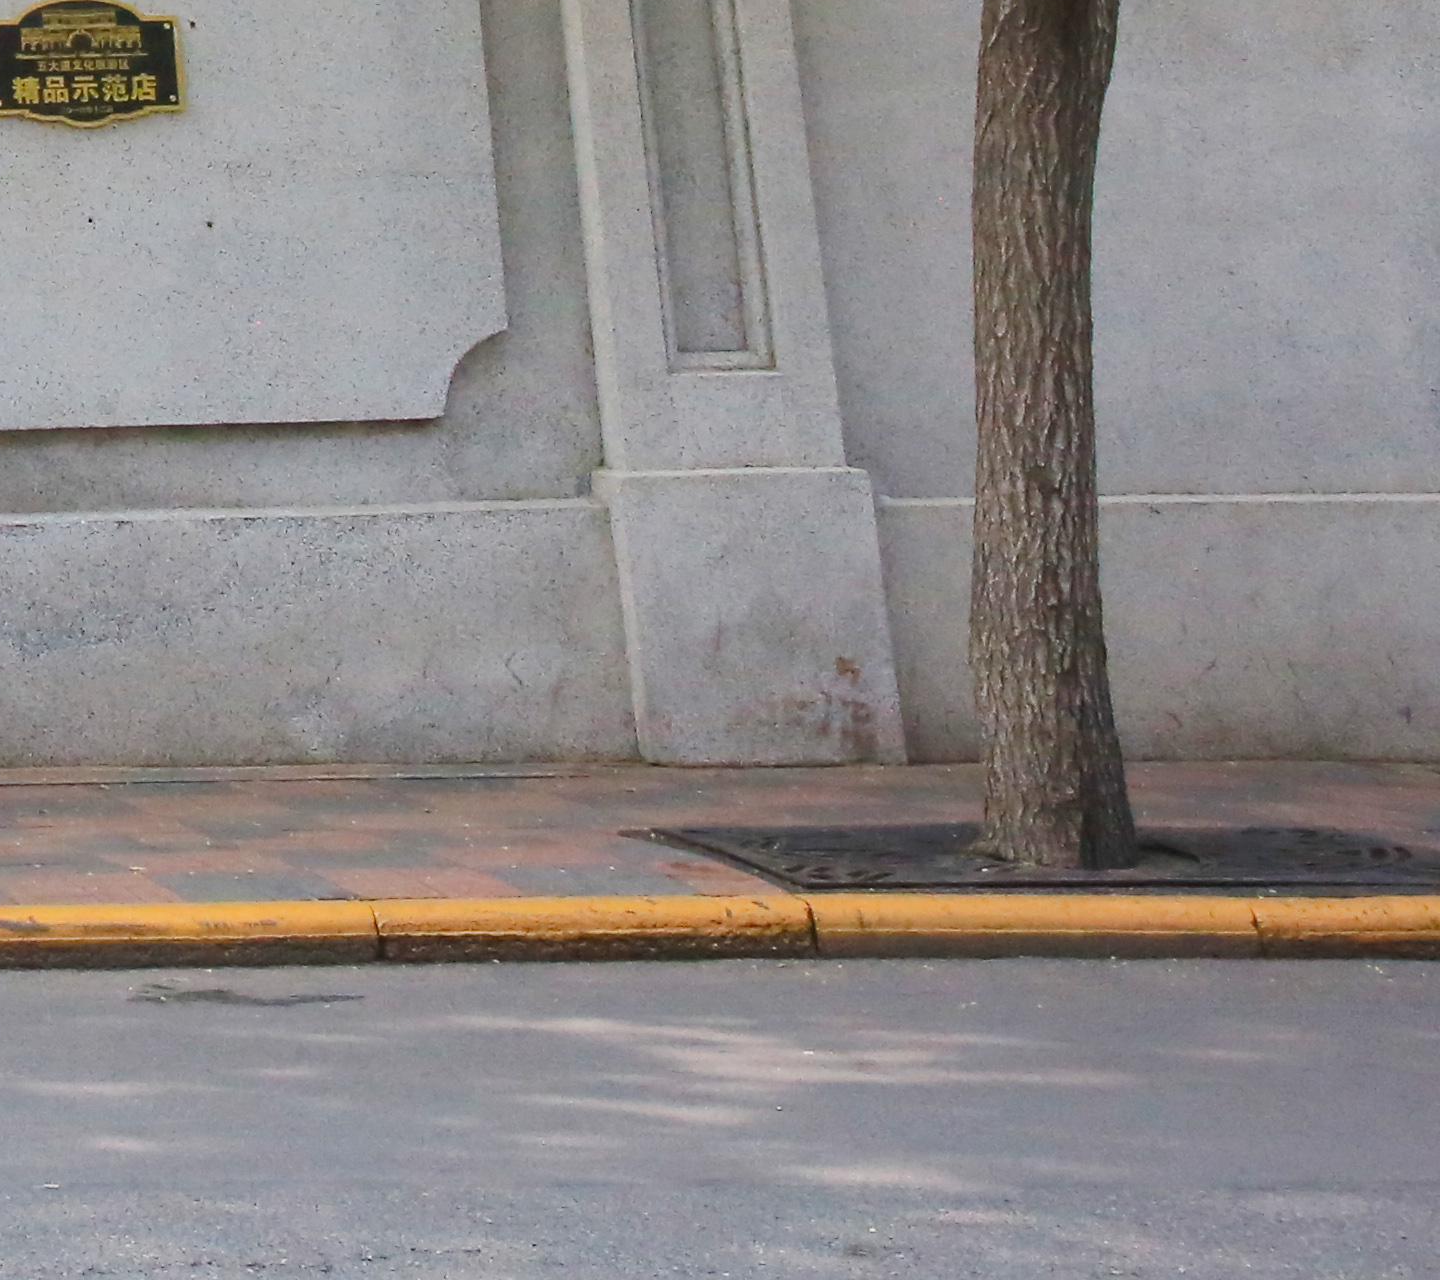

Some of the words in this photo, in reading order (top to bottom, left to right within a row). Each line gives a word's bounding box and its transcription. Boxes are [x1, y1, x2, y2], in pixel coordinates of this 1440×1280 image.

[12, 73, 157, 104] 精品示范店
